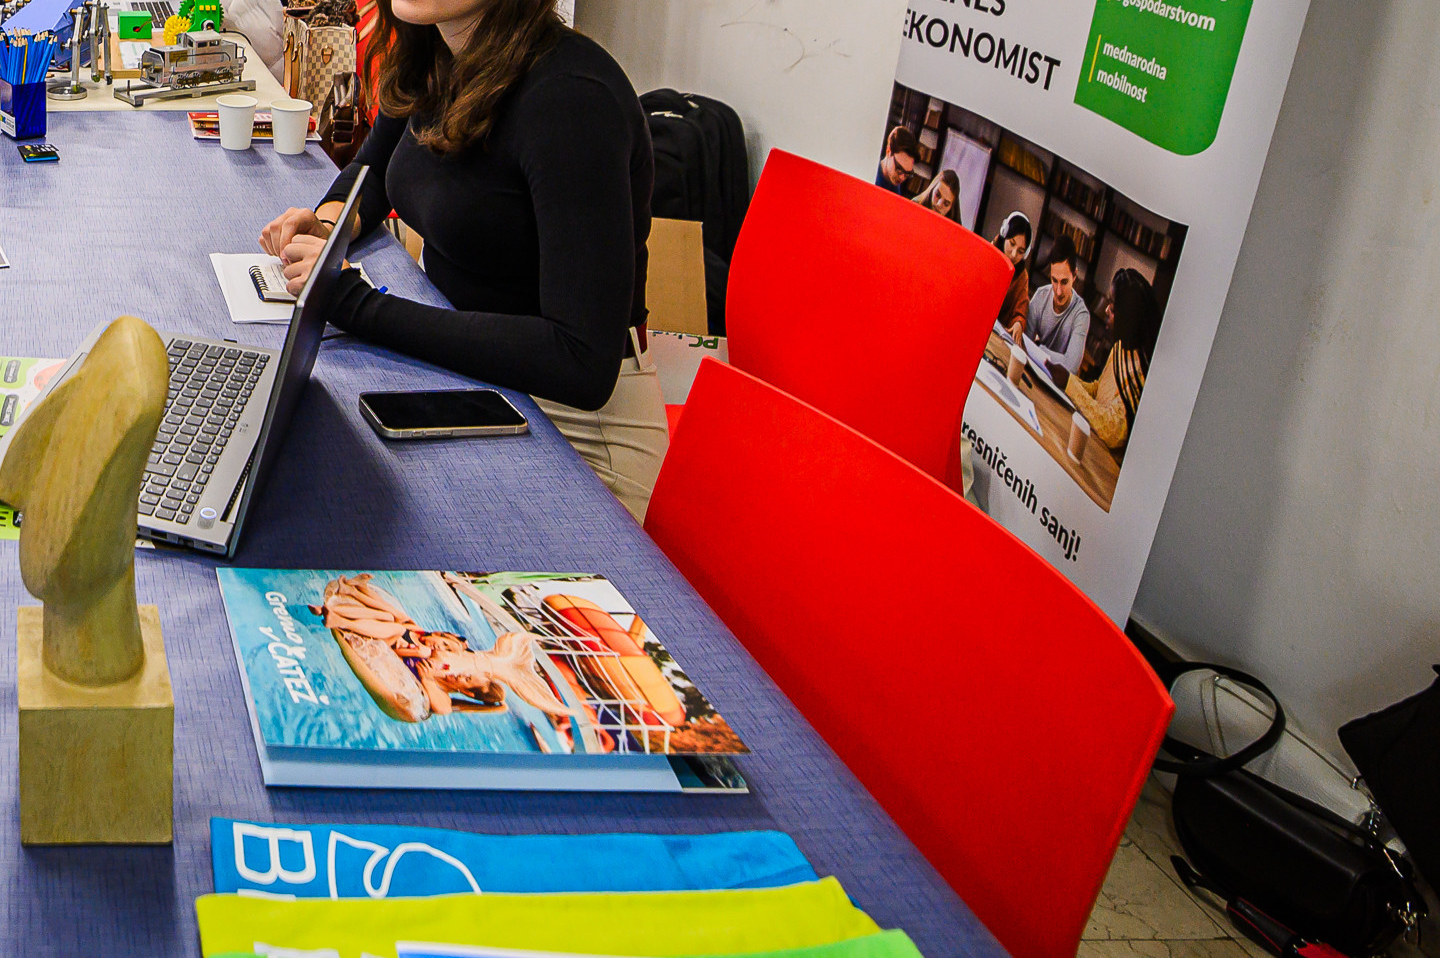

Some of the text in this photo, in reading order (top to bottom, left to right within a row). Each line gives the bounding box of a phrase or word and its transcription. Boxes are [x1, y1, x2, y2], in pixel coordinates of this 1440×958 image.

[1103, 42, 1168, 80] mednarodna
[1096, 68, 1148, 103] mobilnost
[962, 421, 1082, 562] resničenih sanj!
[259, 626, 280, 642] v
[265, 591, 304, 644] Gremo
